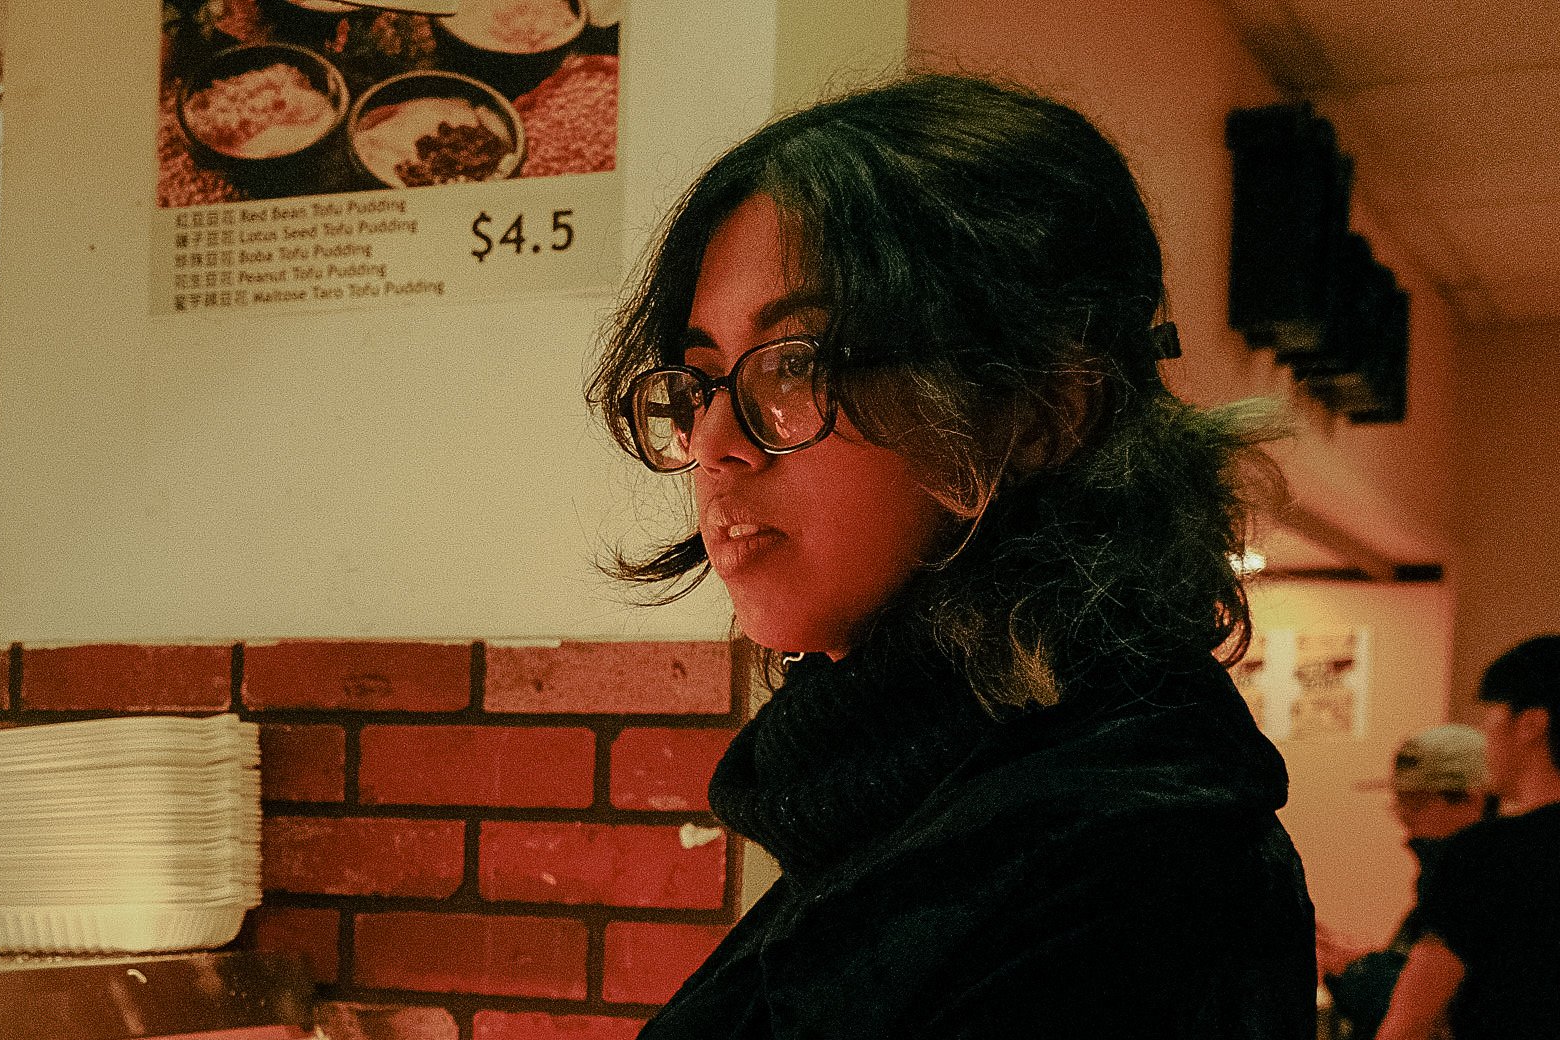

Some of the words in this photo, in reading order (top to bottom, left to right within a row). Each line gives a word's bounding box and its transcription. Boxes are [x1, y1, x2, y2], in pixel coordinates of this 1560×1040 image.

[240, 209, 268, 224] Red
[271, 206, 307, 222] Bean
[312, 202, 344, 217] Tofu
[346, 198, 407, 215] Pudding
[239, 229, 278, 245] Lotus
[283, 225, 319, 240] Seed
[322, 222, 354, 237] Tofu
[357, 218, 419, 236] Pudding
[470, 209, 577, 262] $4.5
[238, 249, 274, 266] Boba
[278, 246, 310, 261] Tofu
[313, 242, 374, 259] Pudding
[238, 268, 288, 284] Peanut
[292, 265, 324, 280] Tofu
[326, 261, 388, 279] Pudding
[252, 287, 308, 305] Maltose
[312, 284, 344, 301] Taro
[348, 282, 380, 298] Tofu
[384, 278, 446, 297] Pudding
